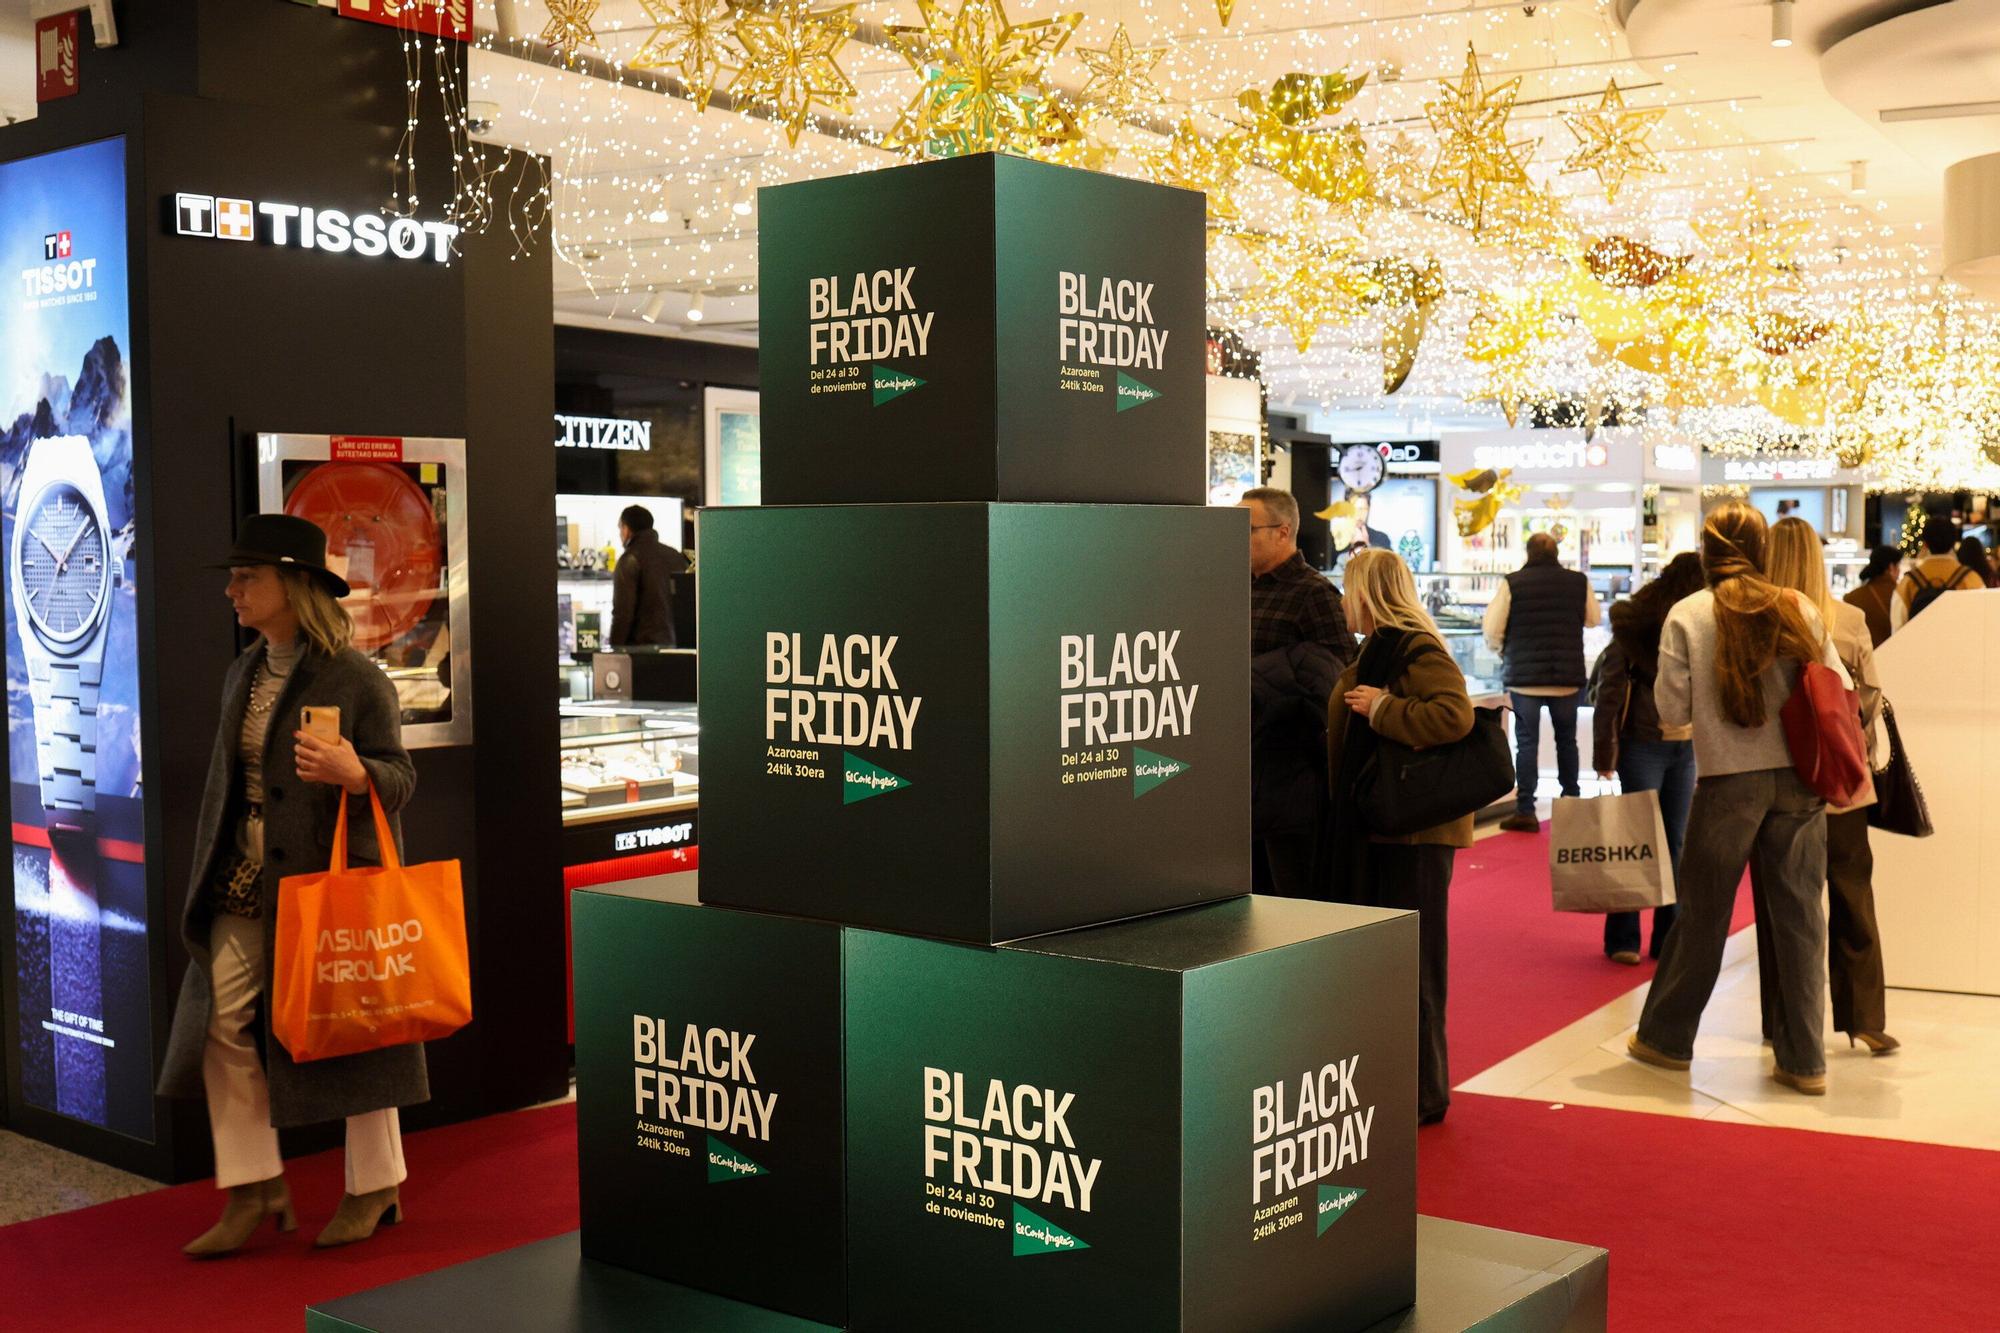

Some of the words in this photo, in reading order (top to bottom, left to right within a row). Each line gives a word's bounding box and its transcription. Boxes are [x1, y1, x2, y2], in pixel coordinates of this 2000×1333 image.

[259, 202, 459, 262] TISSOT
[22, 258, 96, 297] TISSOT
[809, 267, 916, 320] BLACK
[1059, 271, 1154, 325] BLACK
[810, 311, 934, 365] FRIDAY
[1059, 318, 1169, 370] FRIDAY
[810, 370, 824, 380] Del
[826, 369, 836, 378] 24
[838, 368, 846, 378] al
[848, 367, 860, 376] 30
[810, 384, 821, 394] de
[823, 381, 866, 392] noviembre
[1060, 366, 1100, 378] Azaroaren
[1060, 380, 1080, 390] 24tik
[1082, 382, 1104, 392] 30era
[766, 632, 899, 690] BLACK
[1060, 630, 1181, 689] BLACK
[766, 688, 922, 750] FRIDAY
[1060, 684, 1199, 749] FRIDAY
[767, 745, 819, 760] Azaroaren
[1062, 753, 1078, 766] Del
[1080, 751, 1093, 764] 24
[1096, 750, 1104, 762] al
[1106, 749, 1119, 761] 30
[766, 763, 792, 776] 24tik
[795, 764, 825, 778] 30era
[1062, 771, 1074, 784] de
[1077, 766, 1128, 782] noviembre
[1557, 844, 1653, 864] BERSHKA
[317, 919, 423, 952] ASUALDO
[316, 952, 416, 983] KIROLAK
[51, 1008, 64, 1022] THE
[79, 1015, 88, 1028] OF
[634, 1014, 756, 1085] BLACK
[634, 1066, 778, 1142] FRIDAY
[924, 1066, 1076, 1149] BLACK
[1252, 1054, 1359, 1145] BLACK
[637, 1120, 684, 1140] Azaroaren
[637, 1135, 661, 1150] 24tik
[663, 1140, 690, 1157] 30era
[924, 1124, 1102, 1213] FRIDAY
[1253, 1105, 1375, 1205] FRIDAY
[926, 1183, 945, 1197] Del
[947, 1187, 962, 1201] 24
[966, 1190, 976, 1205] al
[979, 1194, 994, 1209] 30
[1254, 1195, 1298, 1223] Azaroaren
[926, 1201, 940, 1213] de
[944, 1206, 1005, 1229] noviembre
[1253, 1222, 1277, 1241] 24tik
[1278, 1212, 1303, 1231] 30era
